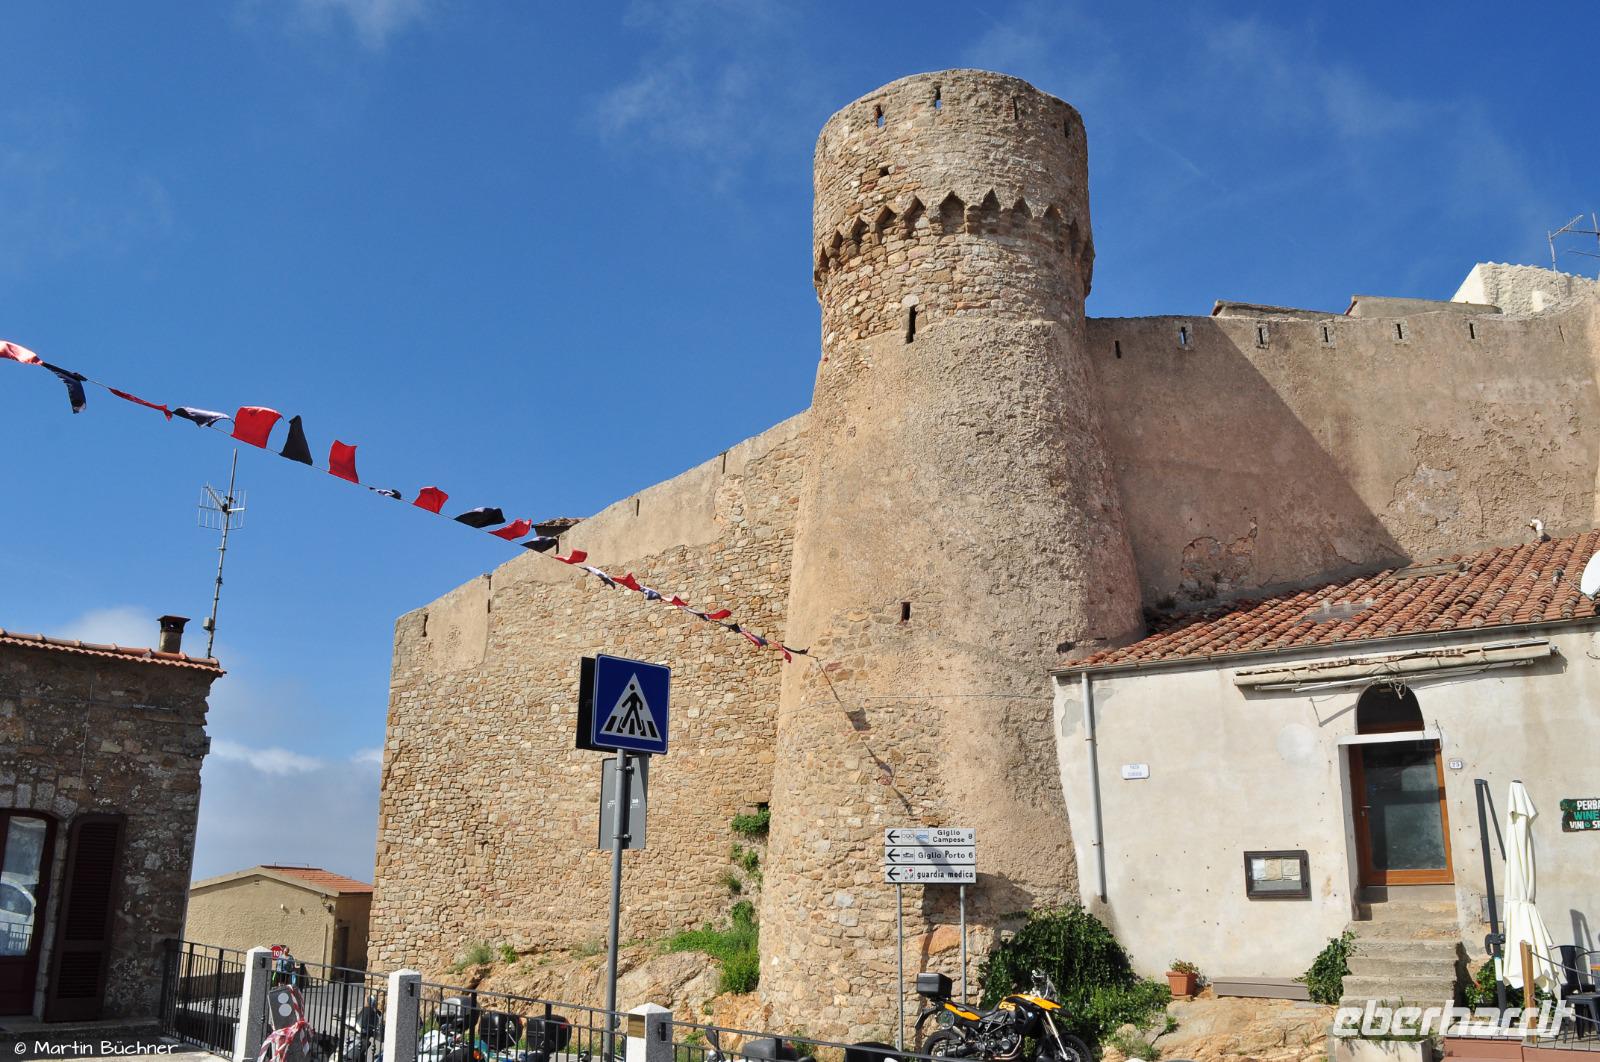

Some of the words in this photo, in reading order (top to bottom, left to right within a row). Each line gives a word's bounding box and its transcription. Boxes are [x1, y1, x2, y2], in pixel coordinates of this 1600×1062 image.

[1574, 810, 1599, 820] WINE
[1569, 820, 1584, 829] VINI
[937, 829, 961, 837] Giglio
[917, 851, 942, 860] Giglio
[944, 850, 966, 859] Porto
[968, 851, 974, 859] 6
[916, 870, 945, 880] guardia
[947, 869, 974, 878] medica
[999, 1001, 1017, 1011] GS
